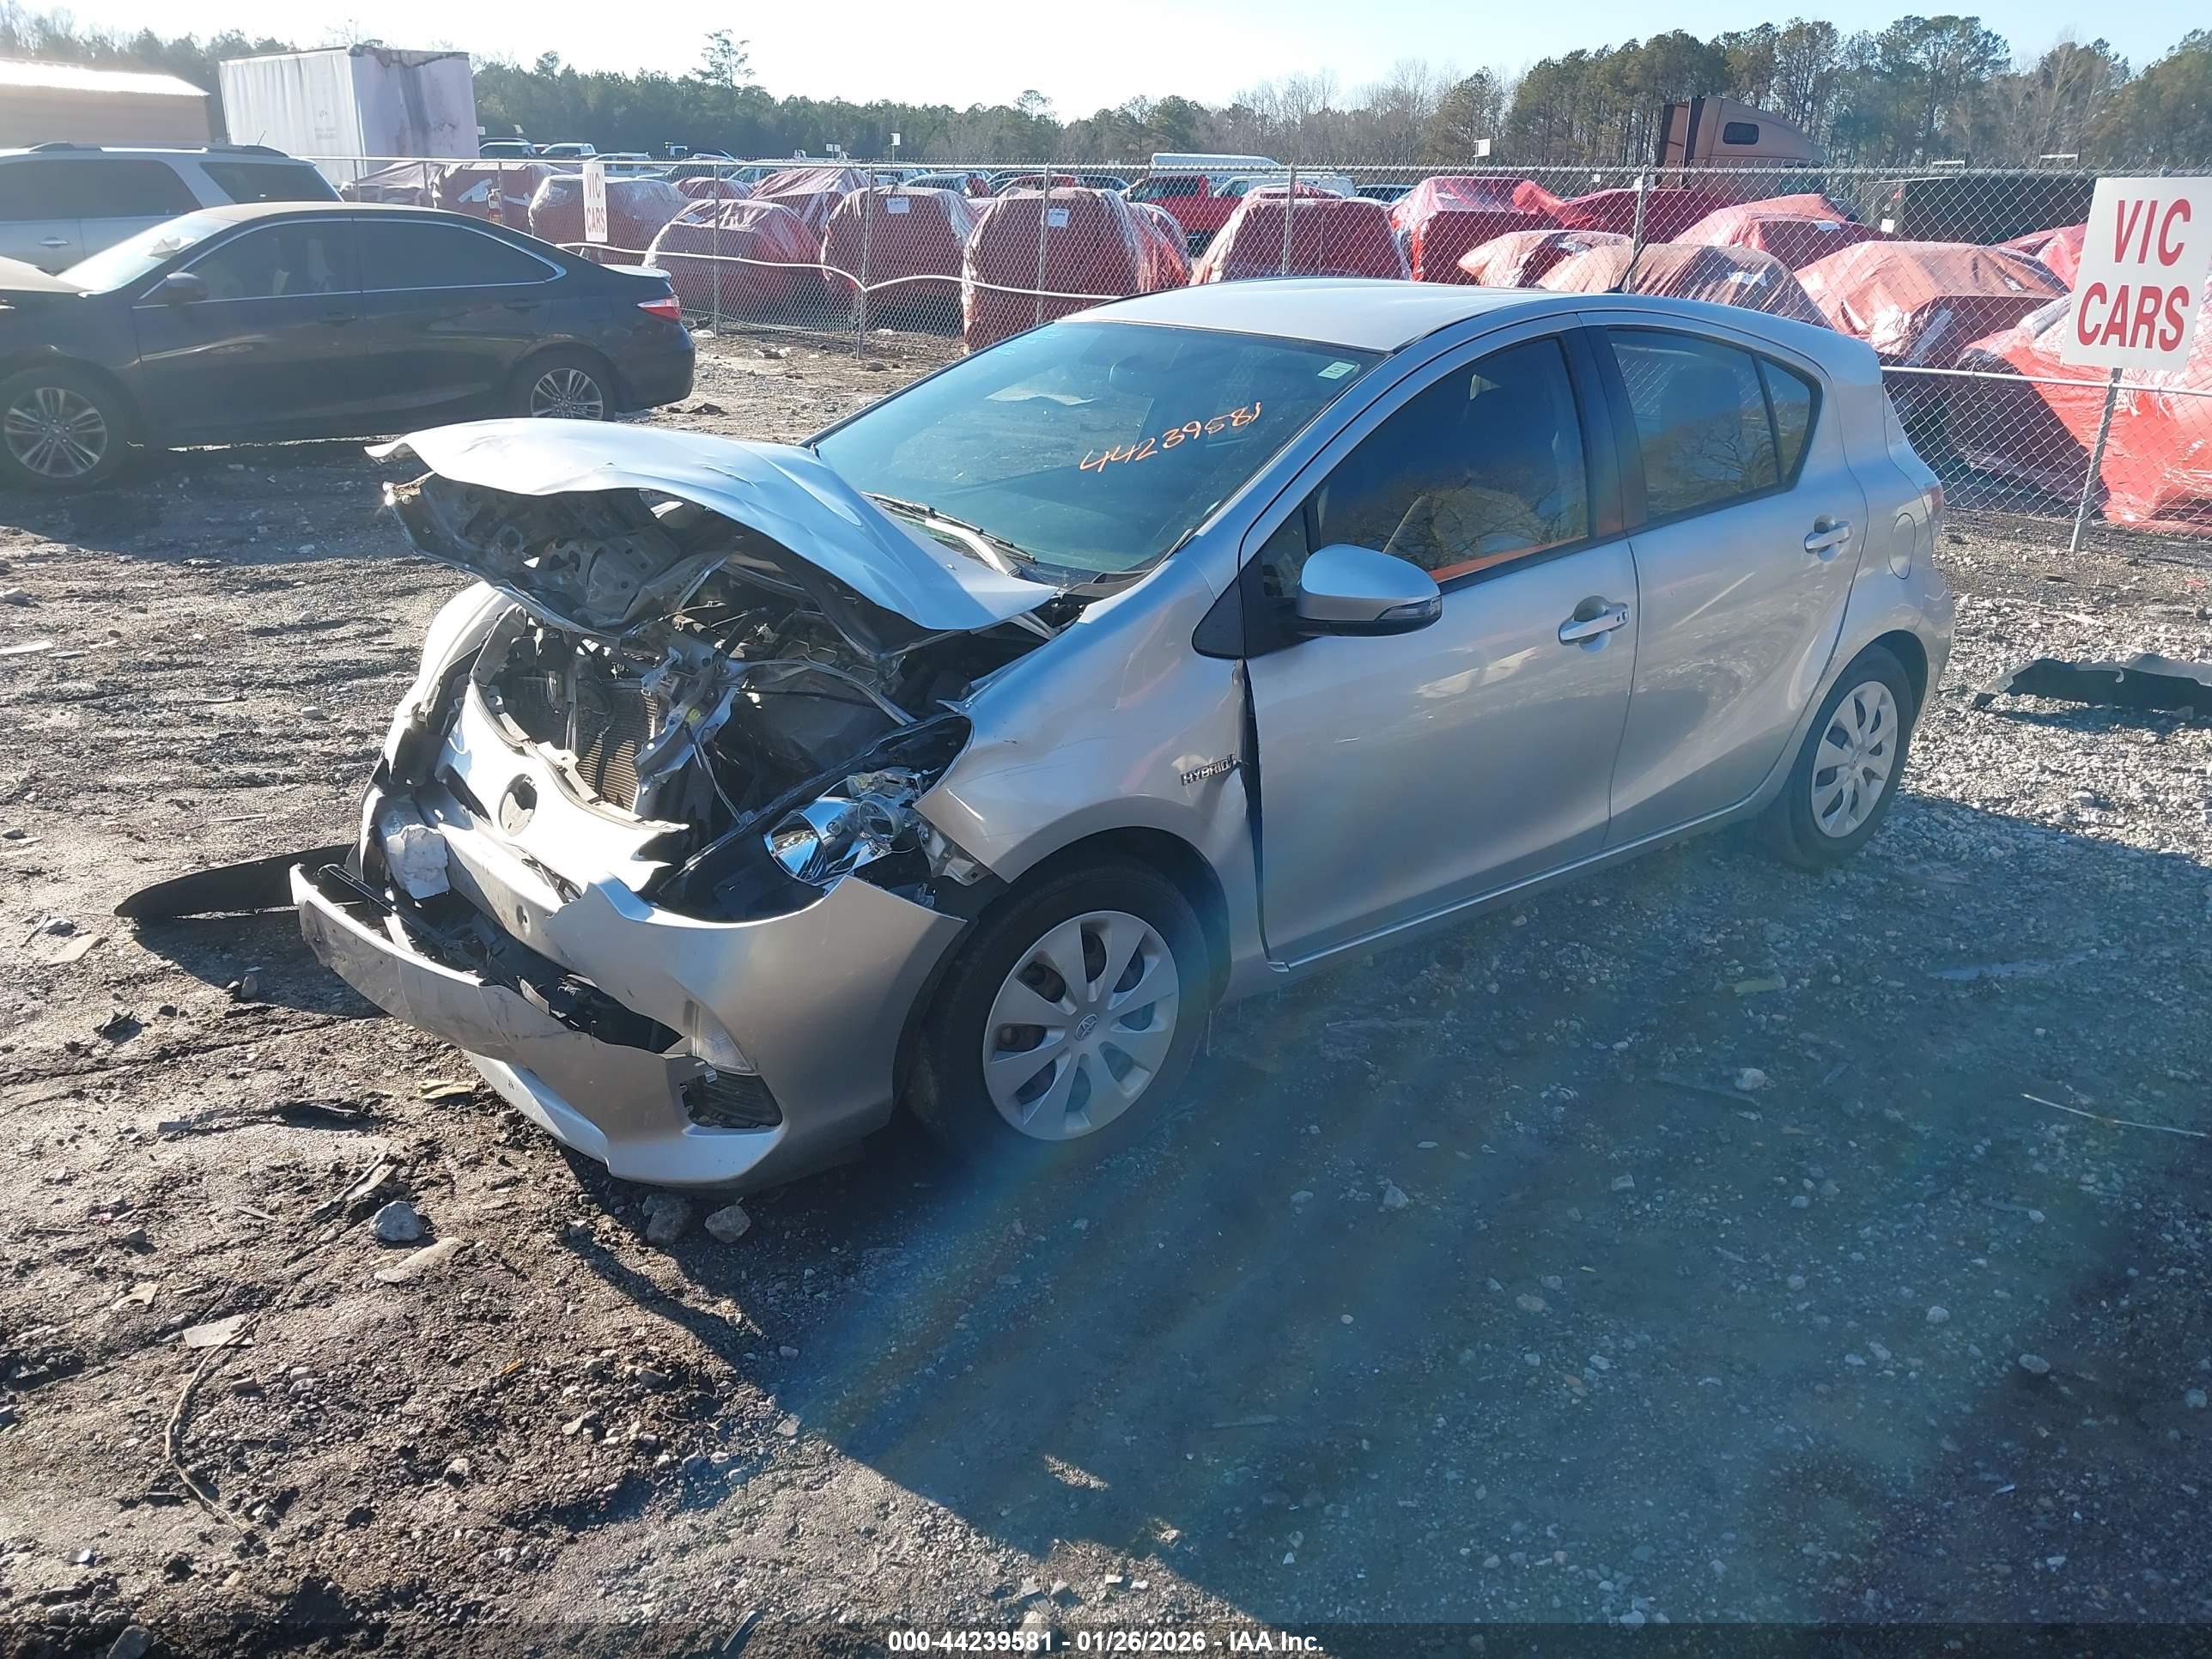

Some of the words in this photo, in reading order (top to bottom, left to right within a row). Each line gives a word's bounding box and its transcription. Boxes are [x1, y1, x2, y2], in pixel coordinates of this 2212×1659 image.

[586, 172, 601, 199] VIC
[586, 206, 605, 234] CARS
[2114, 198, 2191, 266] VIC
[2077, 282, 2190, 352] CARS
[1079, 401, 1262, 472] 44239581
